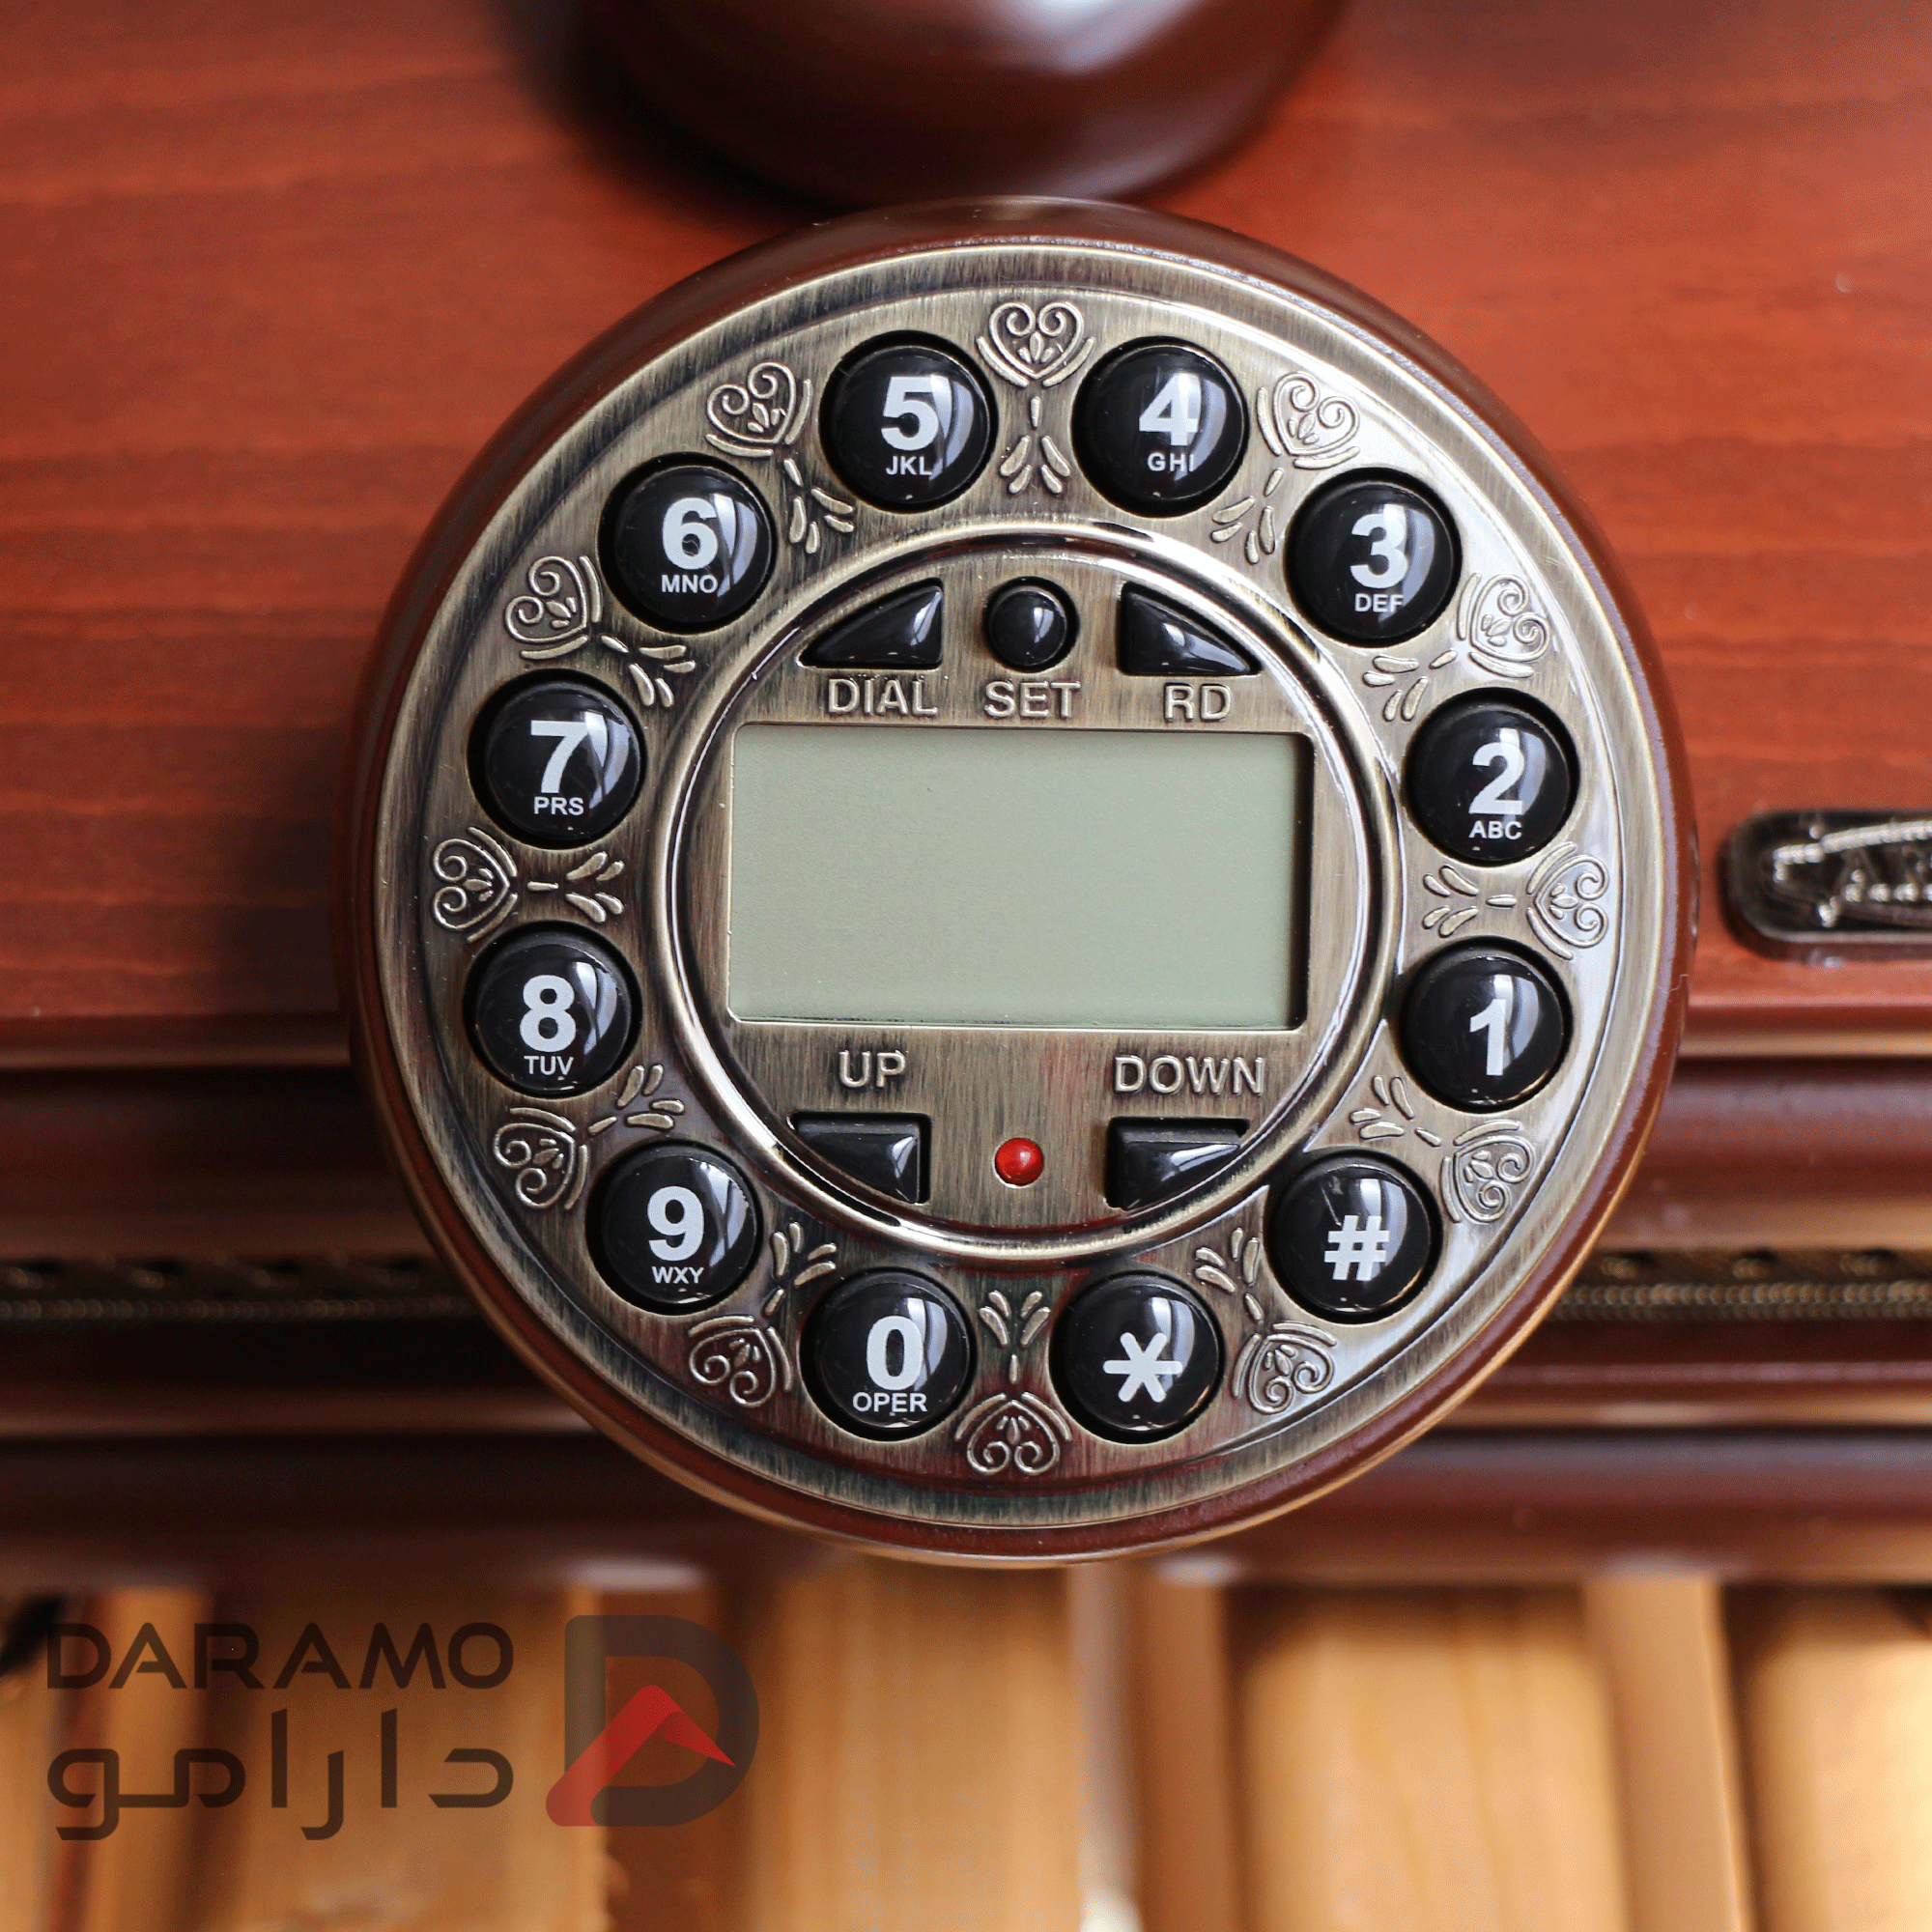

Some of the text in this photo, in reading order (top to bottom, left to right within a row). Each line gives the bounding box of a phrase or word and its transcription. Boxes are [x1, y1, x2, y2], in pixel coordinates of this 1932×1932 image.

[881, 375, 941, 451] 5
[1139, 373, 1200, 446] 4
[886, 455, 933, 475] JKL
[1148, 453, 1196, 471] GHI
[663, 497, 718, 569] 6
[1350, 512, 1408, 588] 3
[661, 575, 719, 593] MNO
[1354, 594, 1404, 612] DEF
[828, 677, 938, 716] DIAL
[983, 679, 1081, 719] SET
[1164, 682, 1233, 723] RD
[530, 720, 588, 794] 7
[1468, 741, 1525, 815] 2
[534, 797, 584, 815] PRS
[1469, 820, 1523, 840] ABC
[520, 974, 577, 1053] 8
[1469, 998, 1507, 1076] 1
[525, 1056, 574, 1075] TUV
[838, 1049, 907, 1089] UP
[1113, 1054, 1265, 1096] DOWN
[647, 1185, 705, 1262] 9
[1323, 1214, 1390, 1281] #
[652, 1266, 704, 1284] WXY
[867, 1315, 923, 1391] 0
[852, 1392, 928, 1413] OPER
